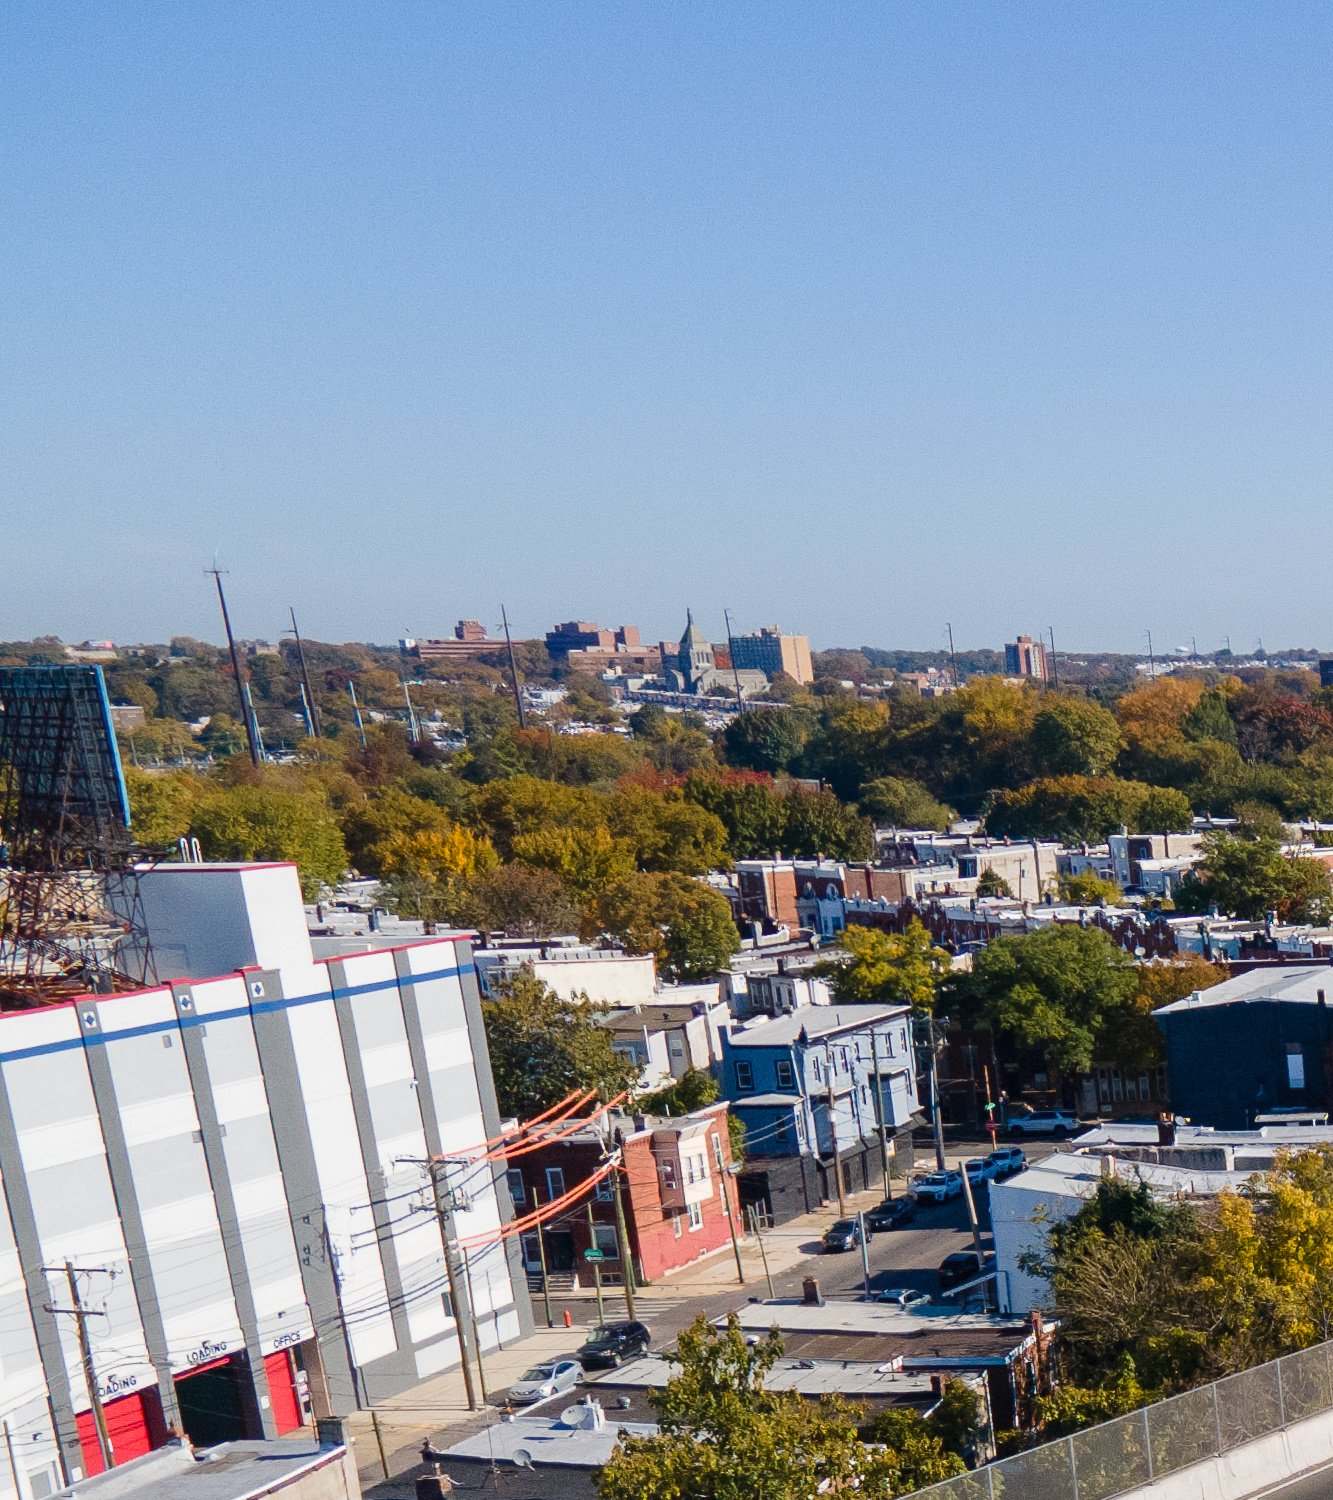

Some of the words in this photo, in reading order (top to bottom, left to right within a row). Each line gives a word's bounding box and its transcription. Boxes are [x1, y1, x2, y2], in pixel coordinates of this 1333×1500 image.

[273, 1330, 301, 1349] OFFICE
[186, 1341, 228, 1365] LOADING
[98, 1375, 138, 1398] OADING
